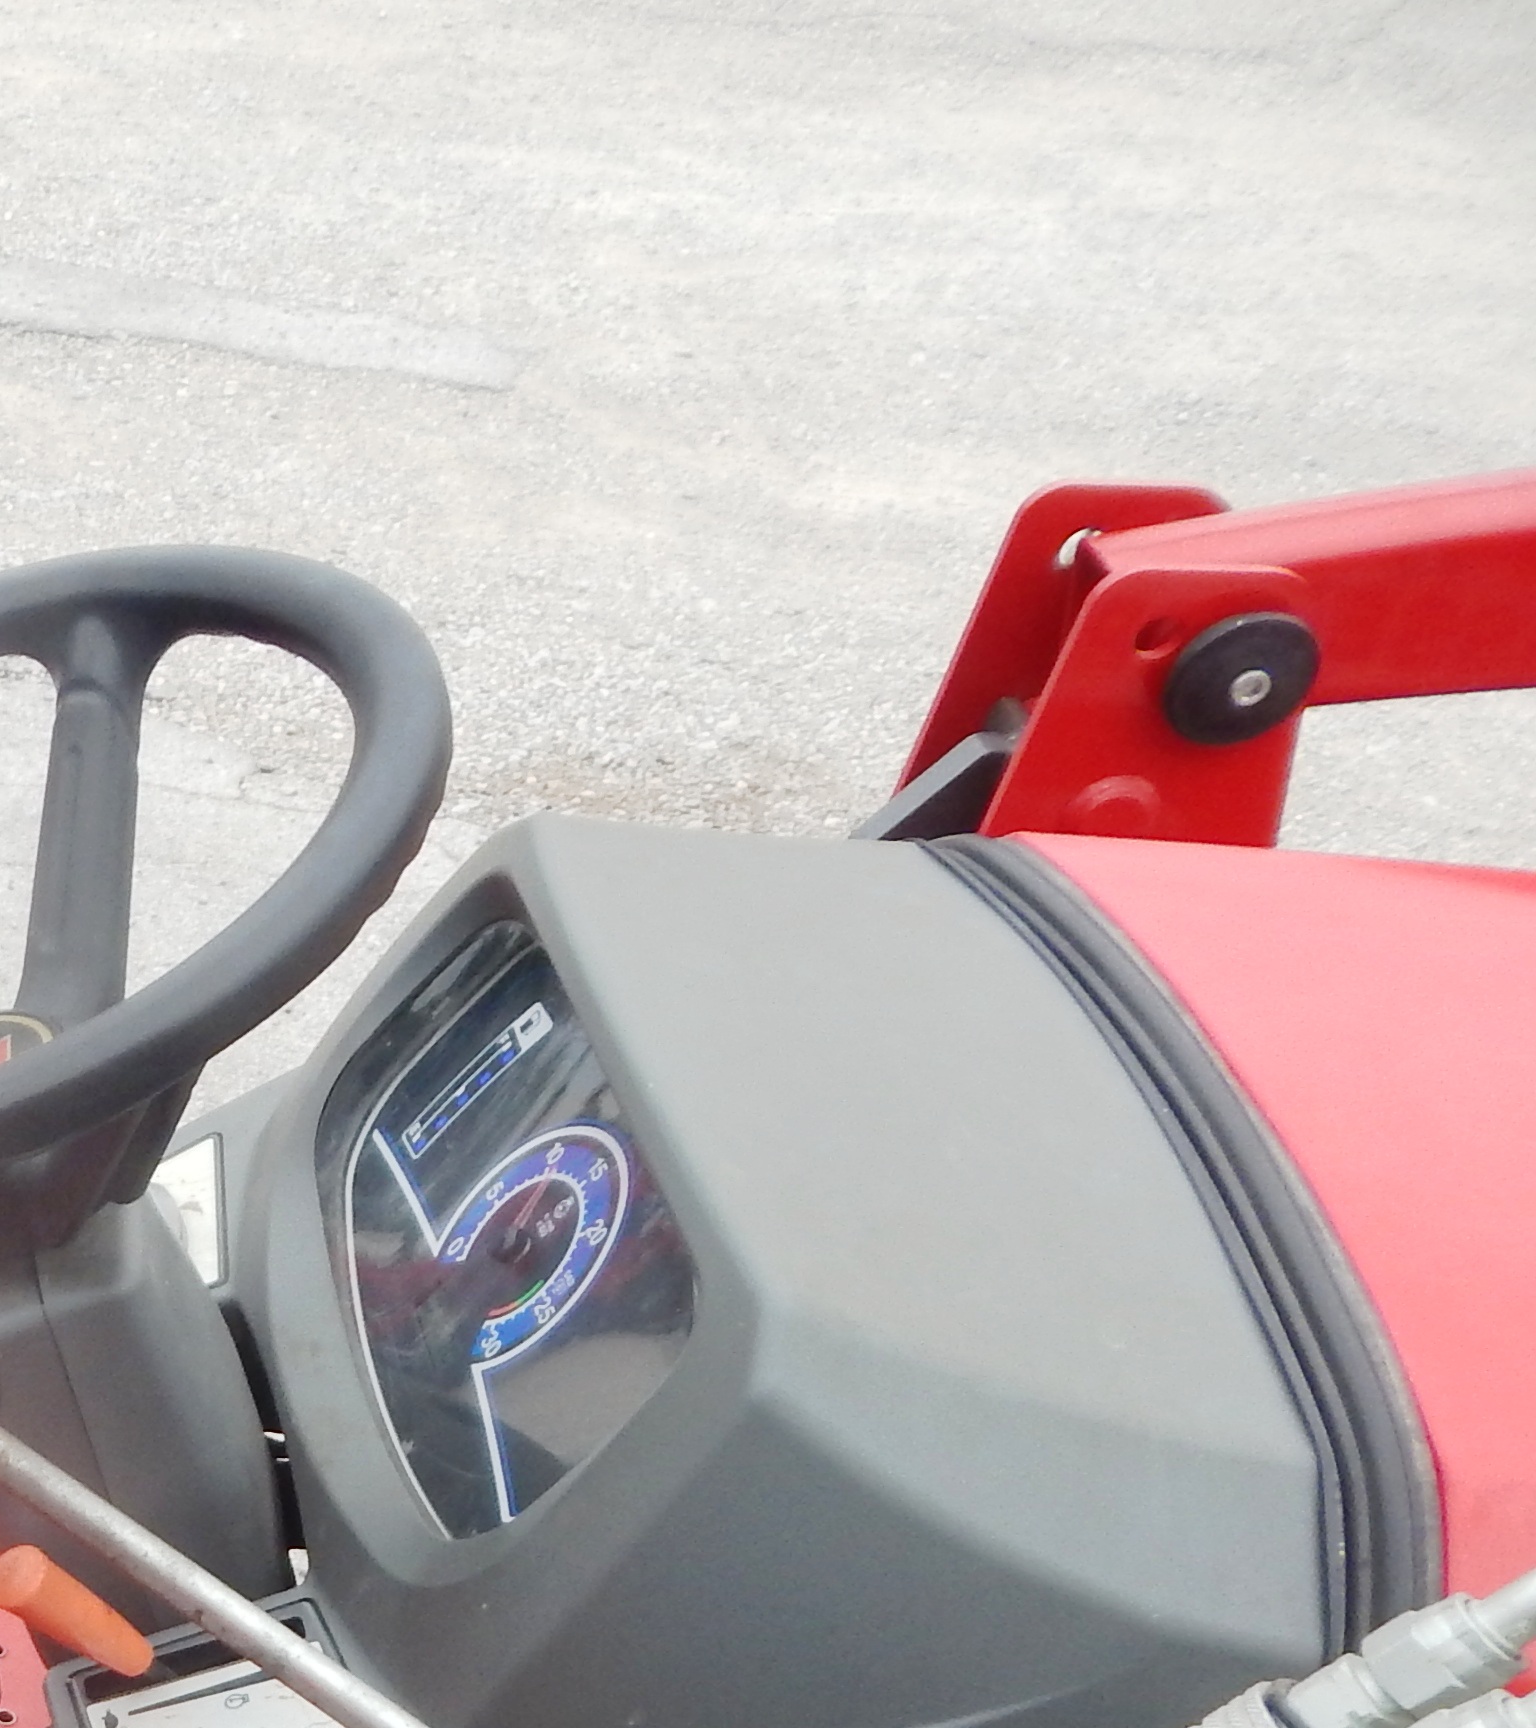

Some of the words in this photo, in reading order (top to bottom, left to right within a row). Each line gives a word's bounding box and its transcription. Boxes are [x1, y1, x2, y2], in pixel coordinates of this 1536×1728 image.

[545, 1142, 565, 1165] 10
[588, 1158, 608, 1182] 15
[485, 1178, 505, 1200] 5
[586, 1218, 608, 1246] 20
[447, 1236, 464, 1256] 0
[533, 1296, 556, 1324] 25
[480, 1330, 502, 1358] 30
